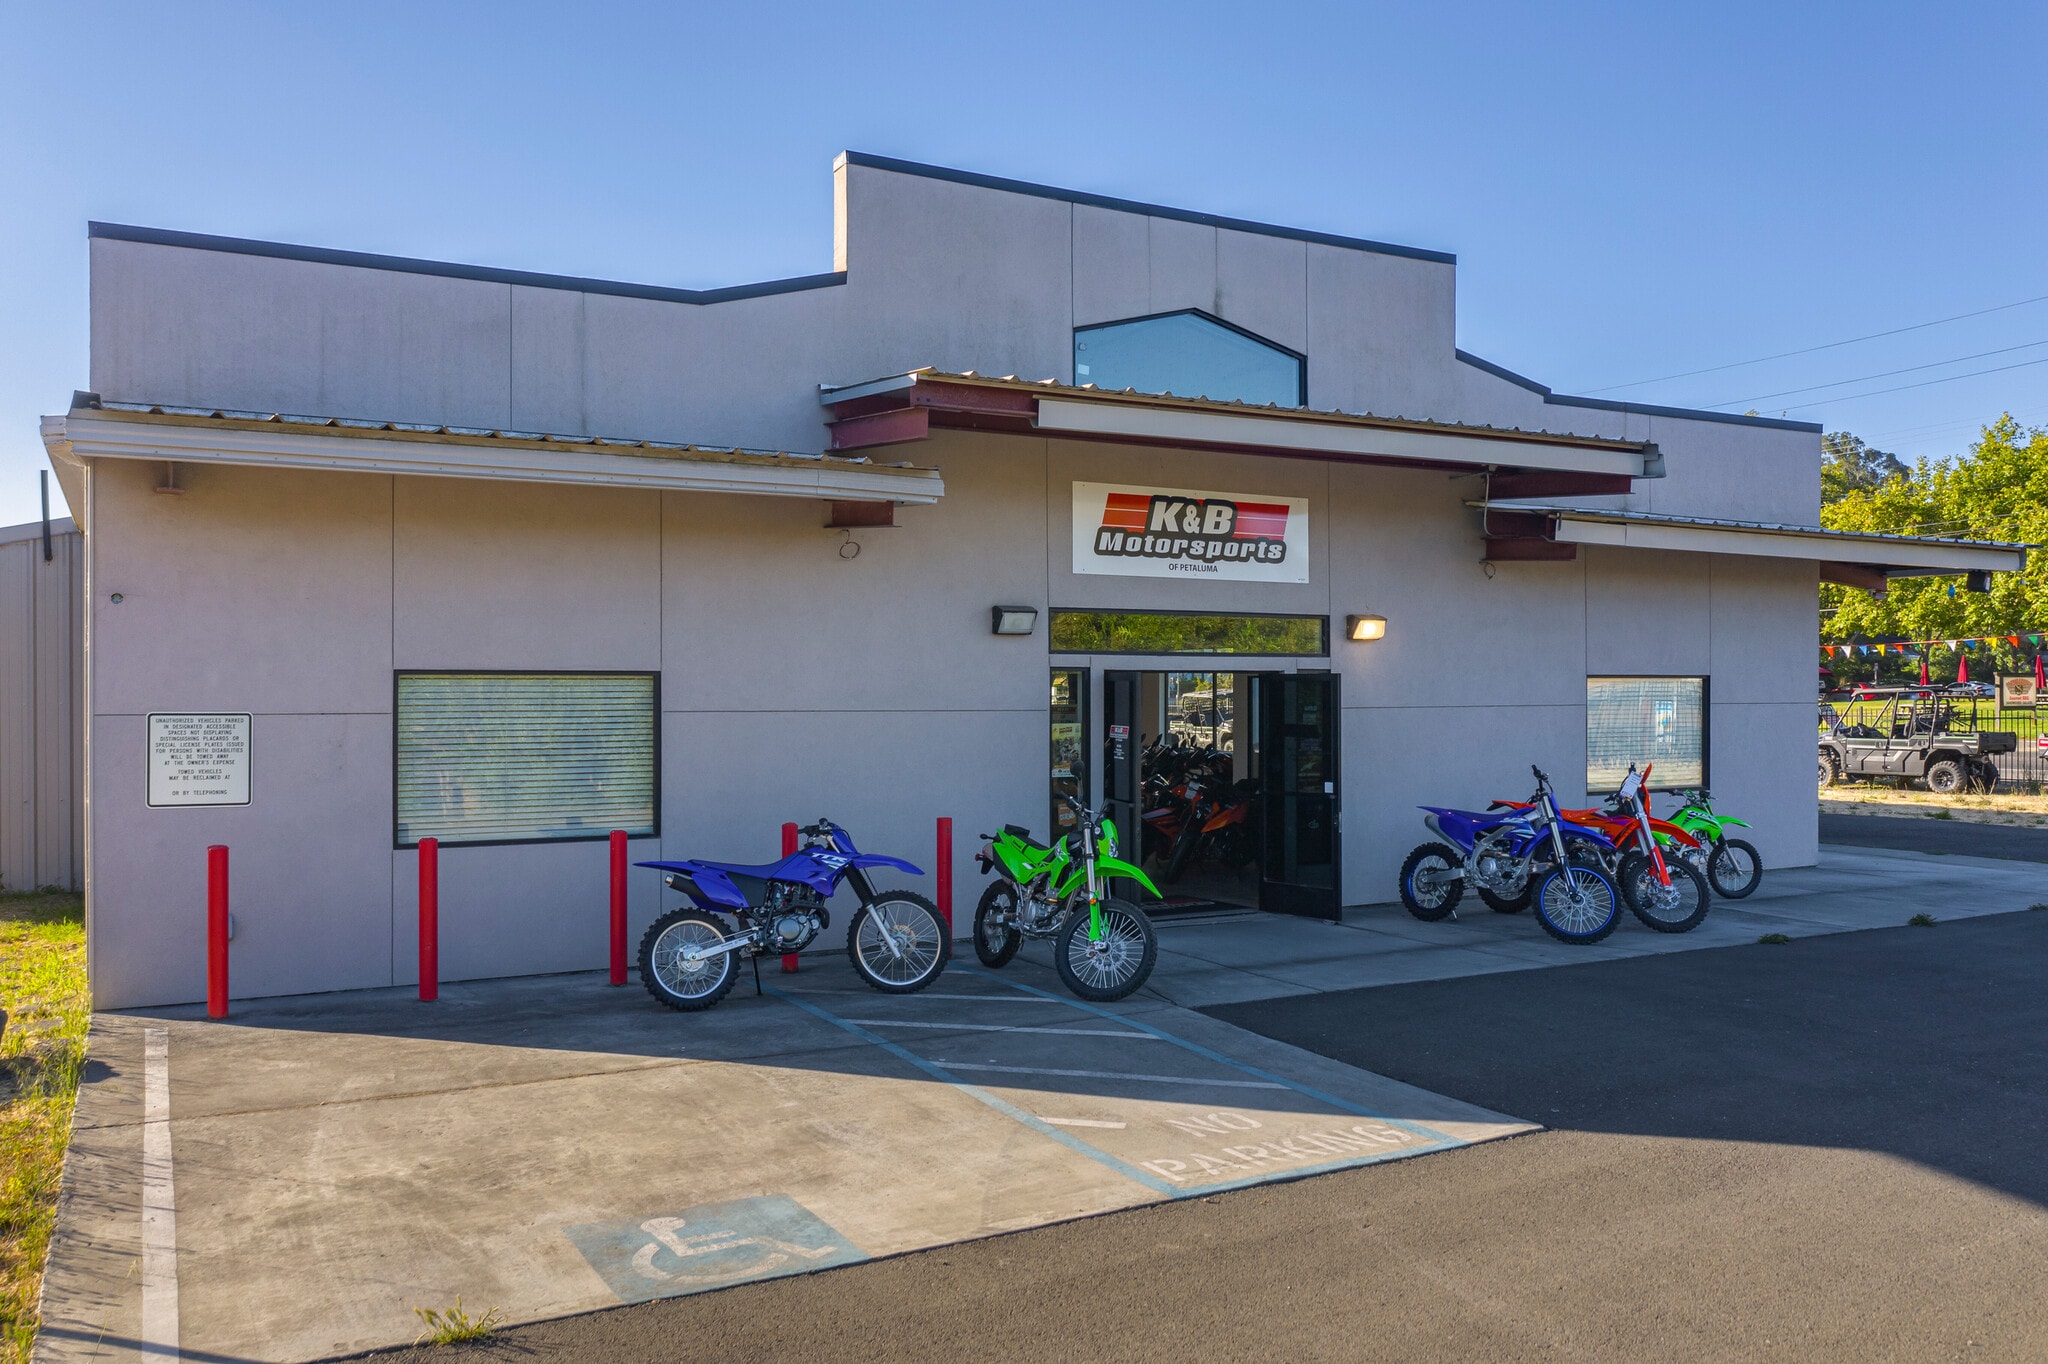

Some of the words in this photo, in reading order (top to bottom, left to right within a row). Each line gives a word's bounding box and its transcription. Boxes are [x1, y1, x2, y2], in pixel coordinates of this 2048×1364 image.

[1150, 501, 1233, 534] K&B
[1099, 532, 1283, 560] Motorsports
[1168, 563, 1179, 571] OF
[1179, 563, 1218, 573] PETALUMA
[1165, 1111, 1263, 1138] NO
[1139, 1124, 1412, 1182] PARKING
